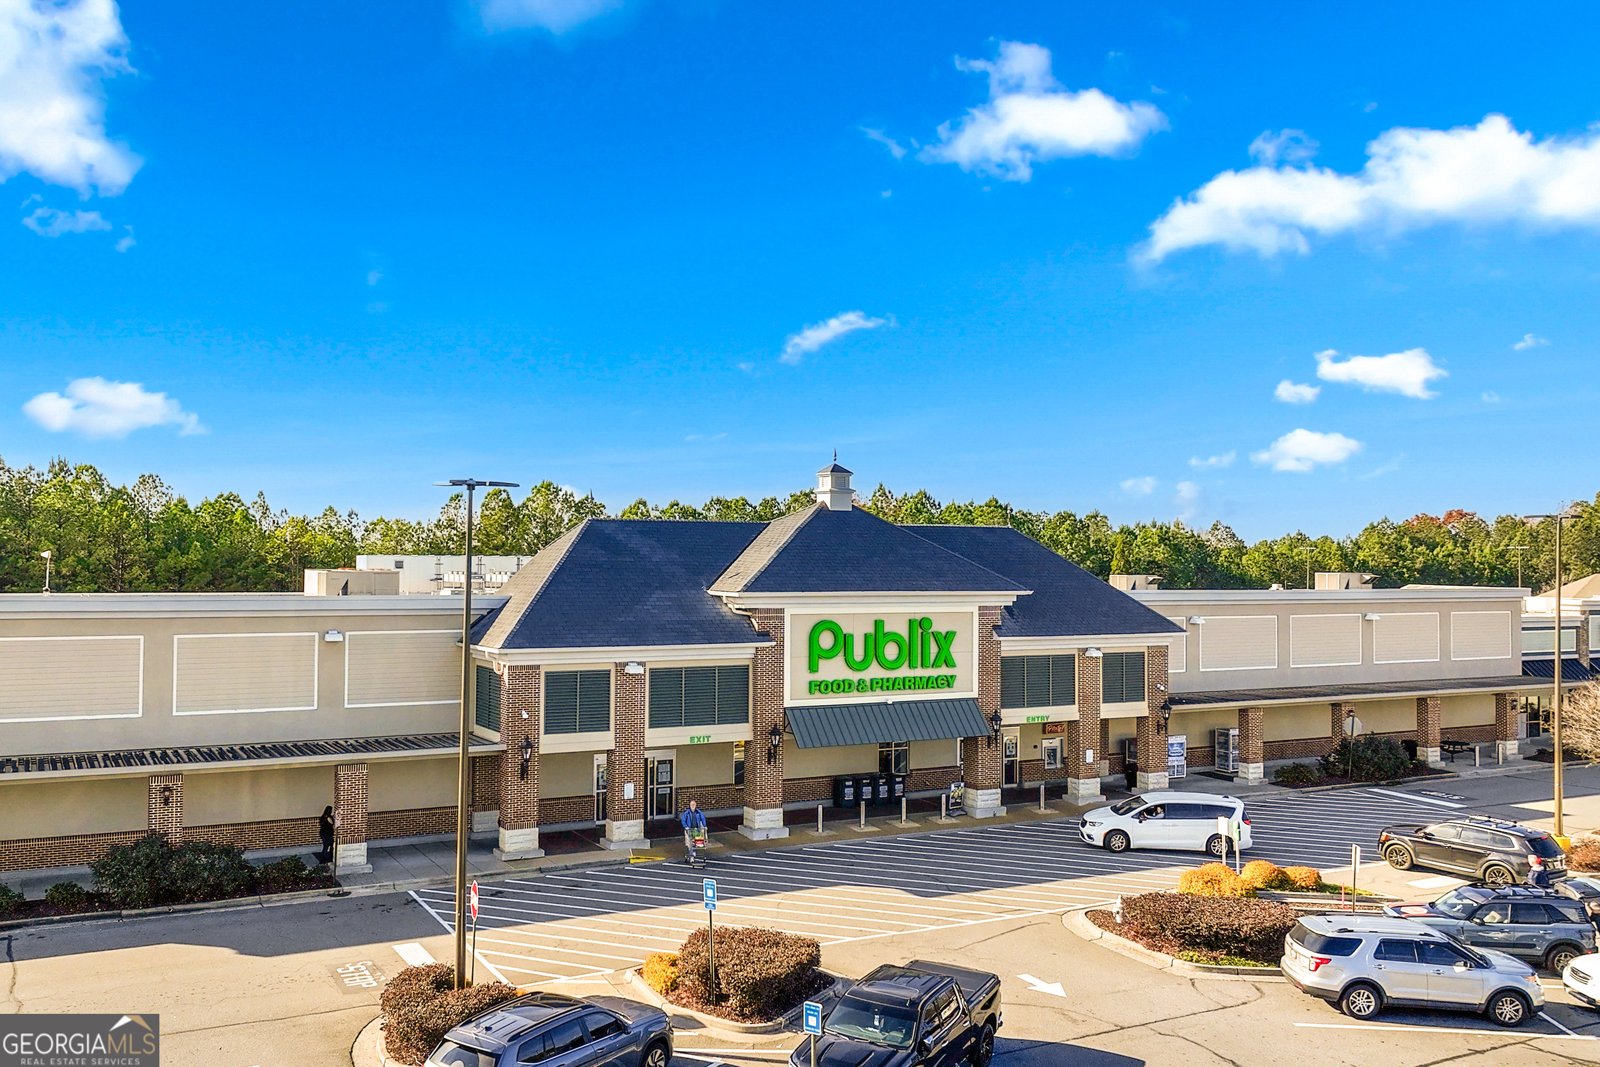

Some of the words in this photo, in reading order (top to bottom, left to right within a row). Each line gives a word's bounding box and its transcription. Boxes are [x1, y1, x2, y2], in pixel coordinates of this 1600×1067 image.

[808, 617, 957, 674] Publix
[808, 679, 855, 695] FOOD
[856, 678, 870, 692] &
[870, 675, 957, 692] PHARMACY
[1026, 715, 1050, 723] ENTRY
